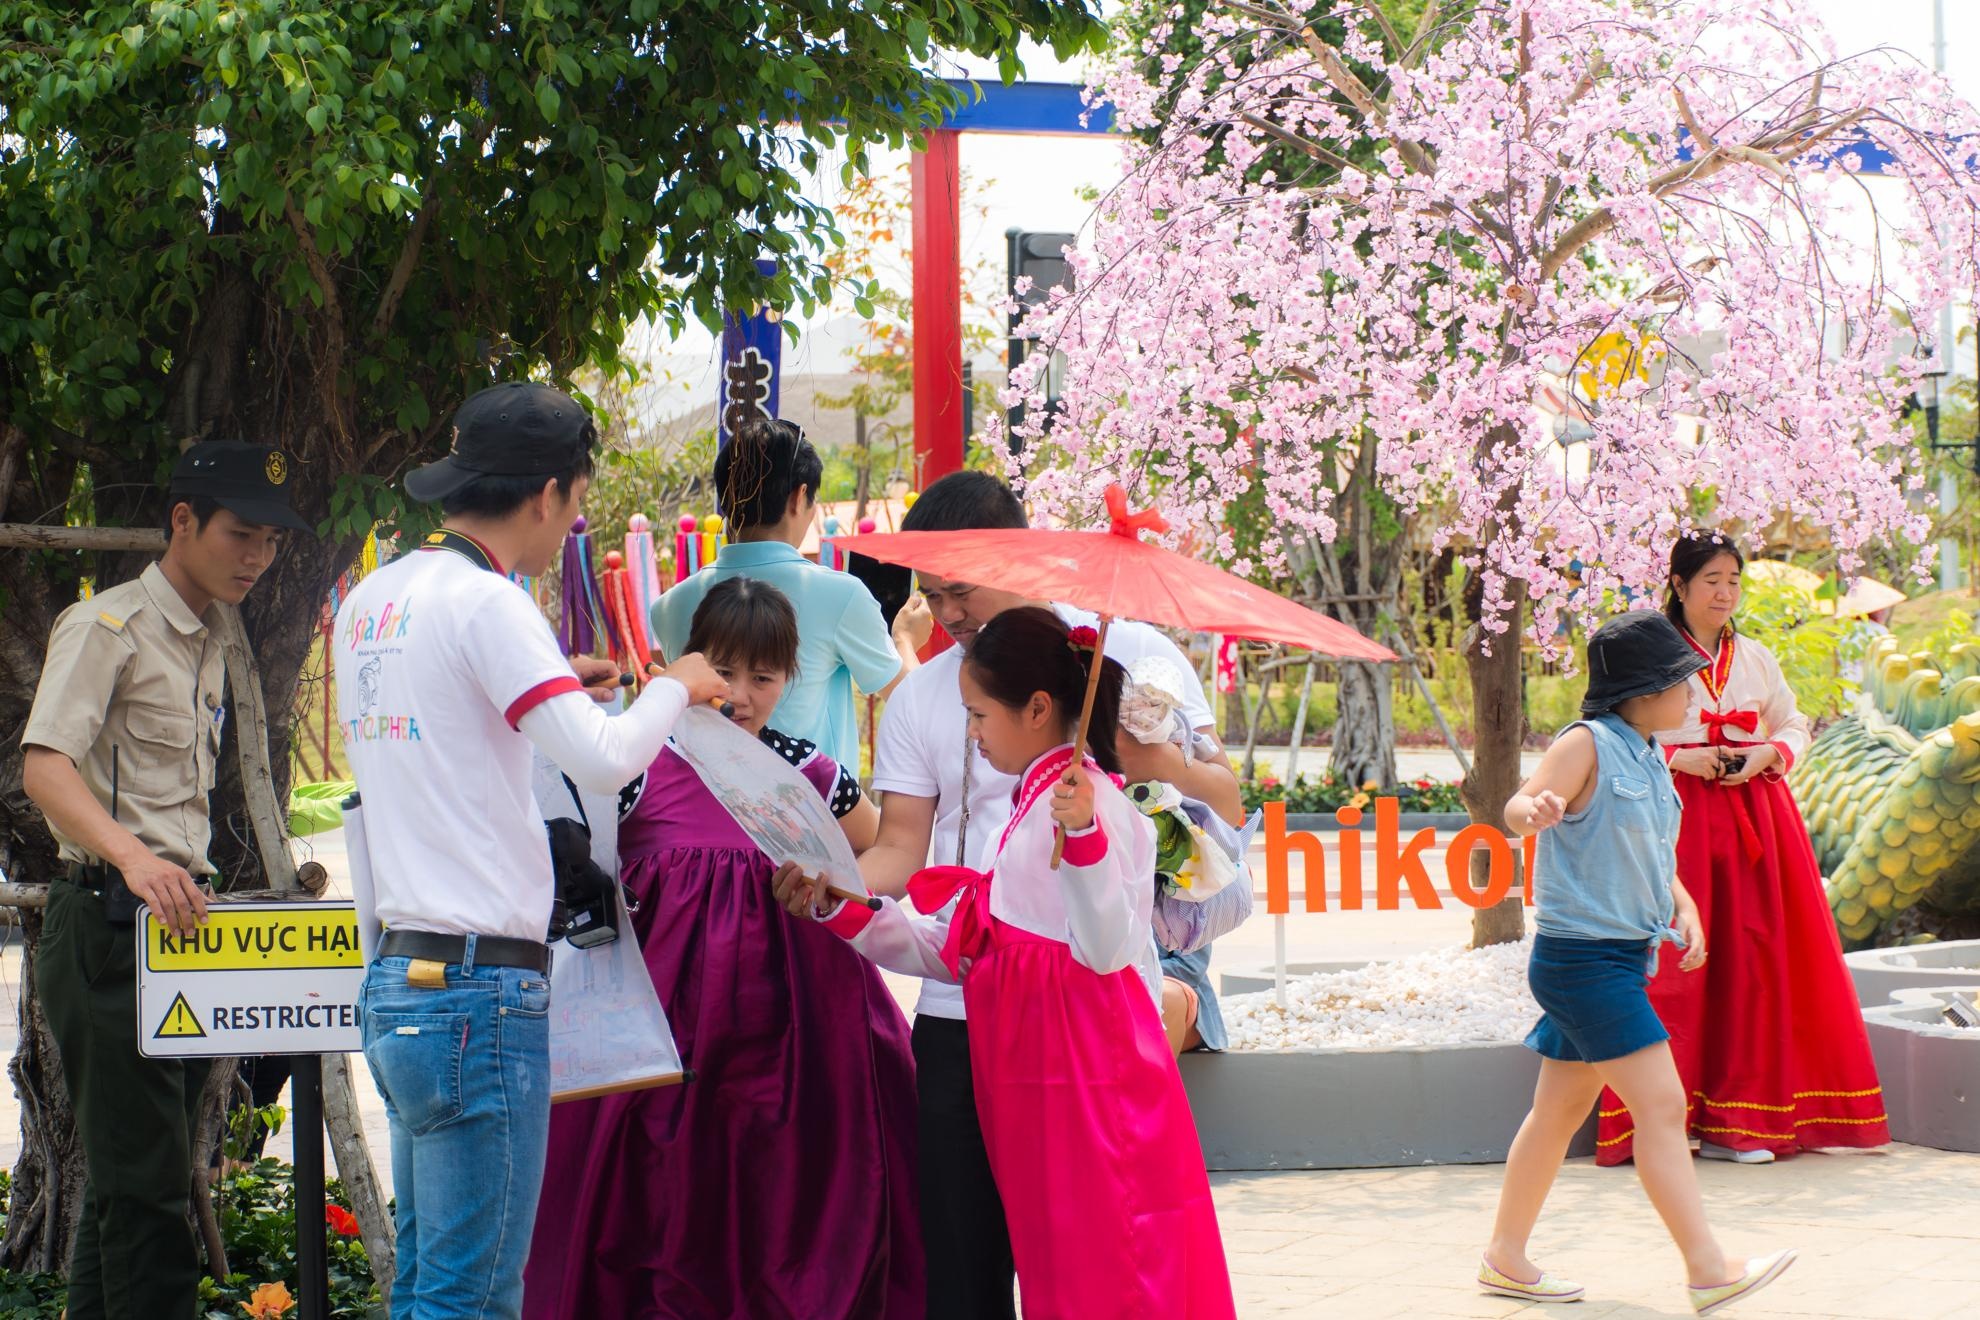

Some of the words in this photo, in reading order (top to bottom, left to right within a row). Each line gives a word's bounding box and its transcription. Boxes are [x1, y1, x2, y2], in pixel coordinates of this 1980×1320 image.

[342, 602, 374, 651] Asia
[375, 596, 411, 642] Park
[1262, 797, 1538, 914] hiko
[159, 927, 223, 954] KHU
[233, 922, 296, 959] VỰC
[308, 925, 359, 958] HẠ
[213, 1004, 360, 1030] RESTRICTE
